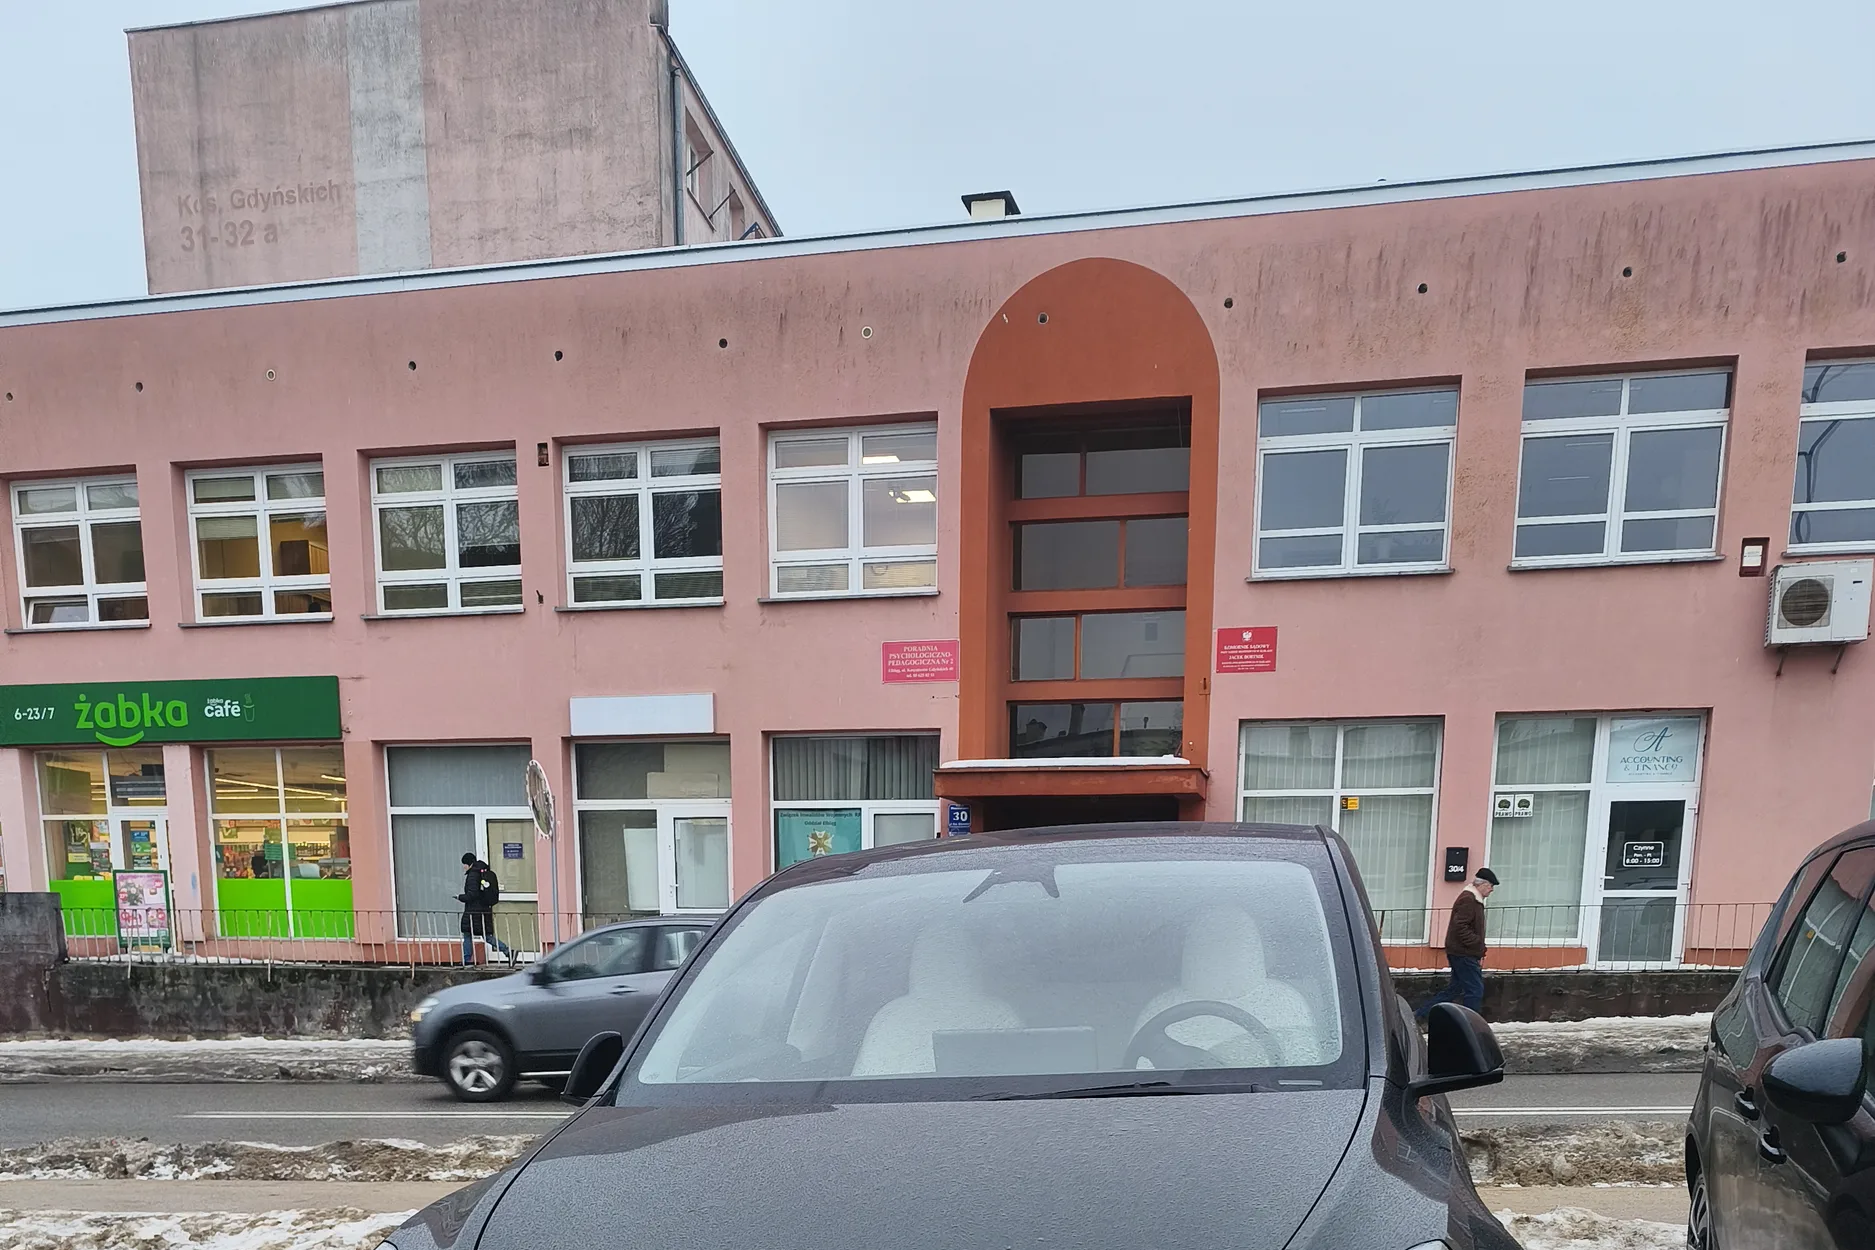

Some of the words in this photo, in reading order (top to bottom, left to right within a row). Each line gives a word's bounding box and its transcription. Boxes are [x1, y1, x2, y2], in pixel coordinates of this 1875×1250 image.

[230, 179, 341, 213] Gdyńskich
[263, 224, 279, 244] a
[14, 707, 55, 721] 6-23/7
[75, 693, 189, 729] żabka
[953, 811, 968, 821] 30
